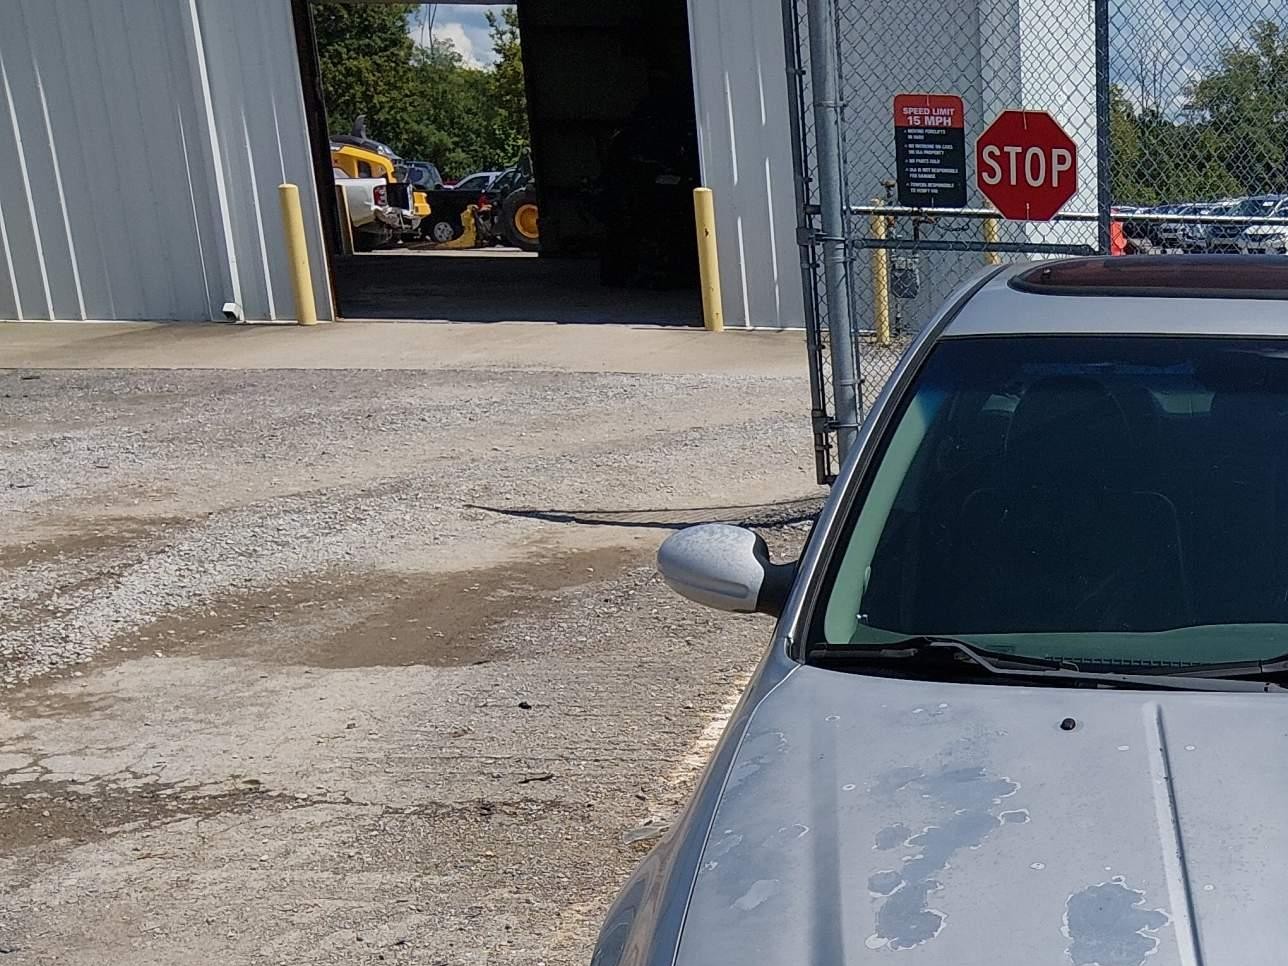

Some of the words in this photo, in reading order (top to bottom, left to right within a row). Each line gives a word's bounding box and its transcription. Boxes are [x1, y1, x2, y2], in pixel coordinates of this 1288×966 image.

[902, 107, 931, 115] SPEED
[932, 108, 956, 116] LIMIT
[907, 115, 921, 126] 15
[924, 116, 952, 127] MPH
[981, 144, 1072, 188] STOP
